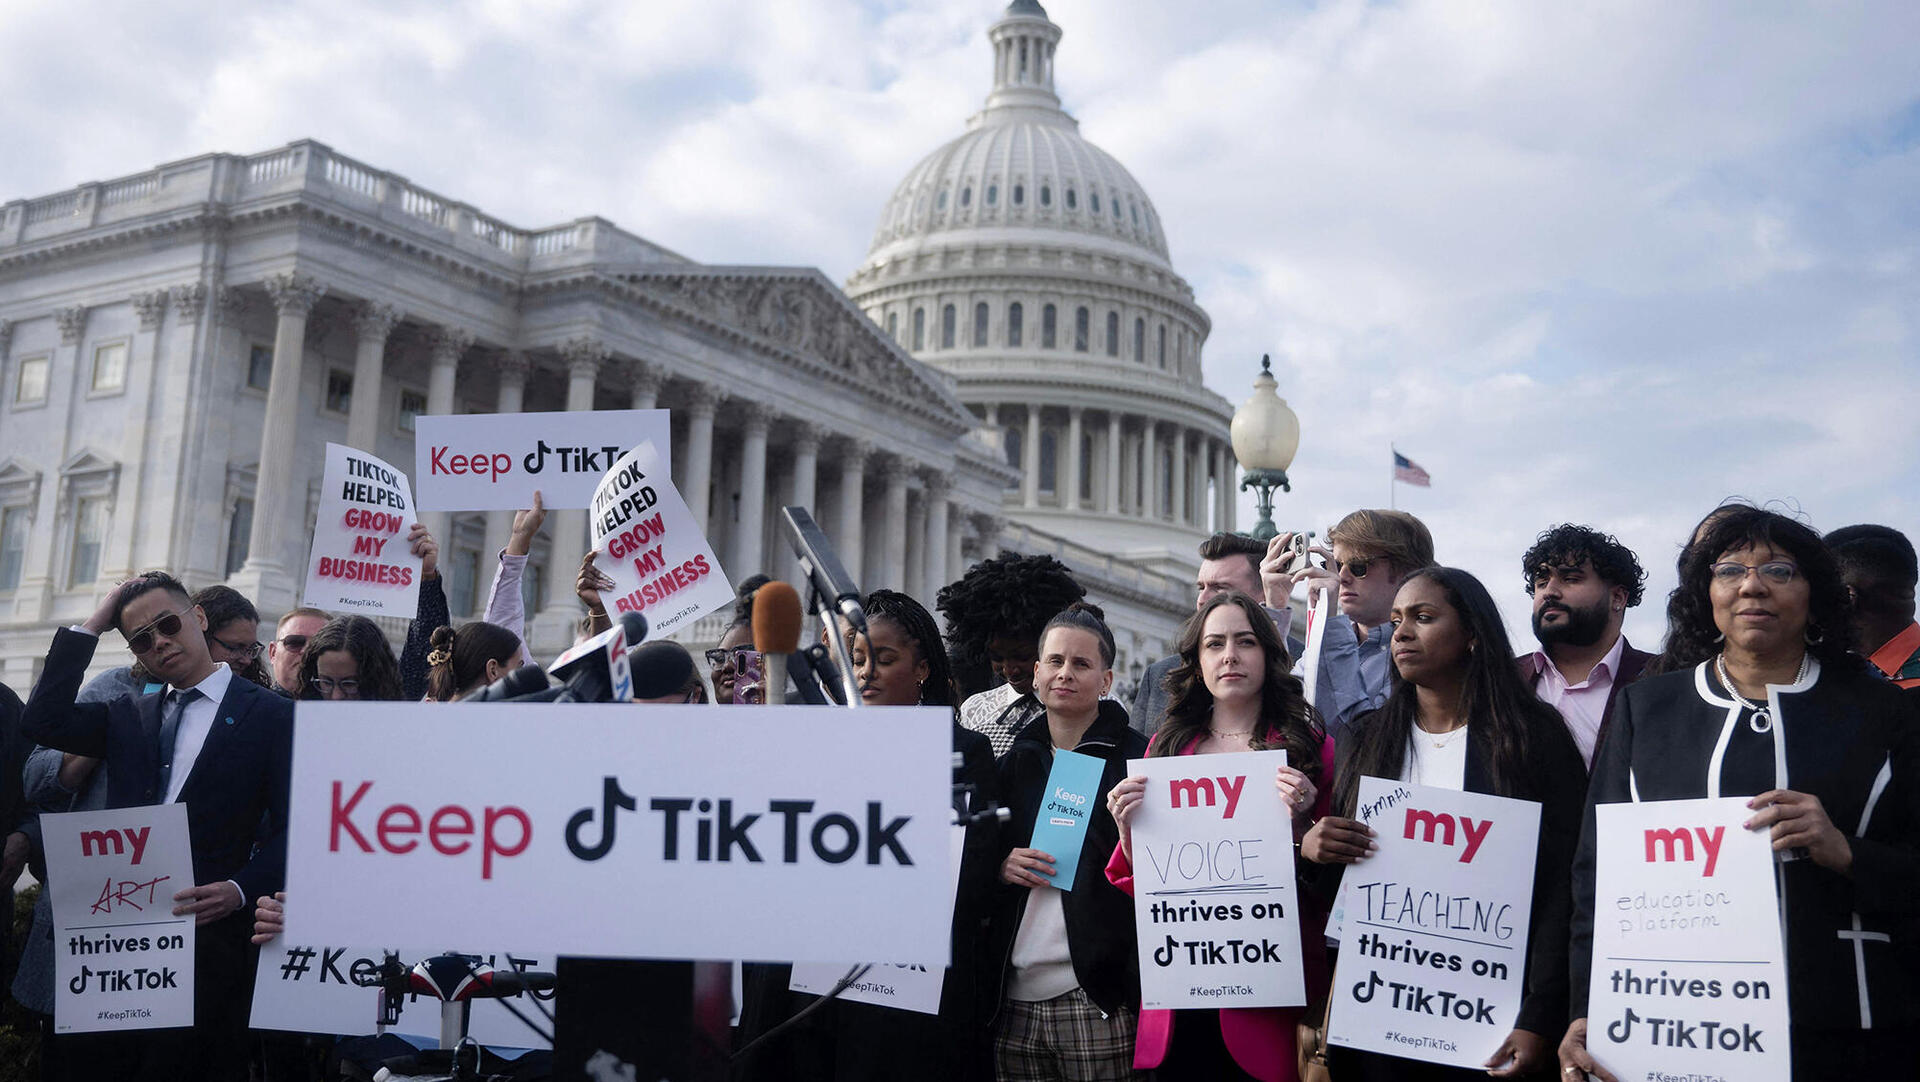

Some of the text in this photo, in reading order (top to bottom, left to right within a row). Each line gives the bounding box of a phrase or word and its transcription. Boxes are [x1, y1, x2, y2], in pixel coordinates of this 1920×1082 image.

[346, 457, 401, 490] TIKTOK
[431, 446, 630, 483] Keep TikT
[342, 481, 406, 510] HELPED
[595, 460, 646, 513] TIKTOK
[345, 508, 403, 534] GROW
[596, 486, 658, 539] HELPED
[354, 535, 388, 557] MY
[608, 512, 665, 559] GROW
[319, 557, 413, 587] BUSINESS
[634, 544, 666, 578] MY
[615, 553, 711, 613] BUSINESS
[339, 597, 384, 608] #KeepTikTok
[656, 603, 700, 630] #KeepTikTok
[1054, 786, 1086, 806] Keep
[1057, 804, 1084, 818] TikTok
[1169, 775, 1247, 819] my
[80, 826, 151, 865] my
[328, 780, 914, 880] Keep TikTok
[1403, 807, 1494, 864] my
[1146, 840, 1264, 884] VOICE
[1644, 826, 1726, 878] my
[91, 876, 170, 915] ART
[1150, 900, 1284, 923] thrives on
[1357, 882, 1513, 940] TEACHING
[1616, 890, 1731, 911] education
[1617, 911, 1721, 938] platform
[69, 933, 184, 955] thrives on
[1183, 939, 1282, 965] TikTok
[1358, 933, 1508, 980] thrives on
[97, 967, 177, 992] TikTok
[1189, 986, 1254, 998] #KeepTikTok
[1611, 968, 1771, 1000] thrives on
[97, 1009, 152, 1021] #KeepTikTok
[1388, 981, 1496, 1025] TikTok
[1385, 1030, 1458, 1053] #KeepTikTok
[1646, 1017, 1765, 1053] TikTok
